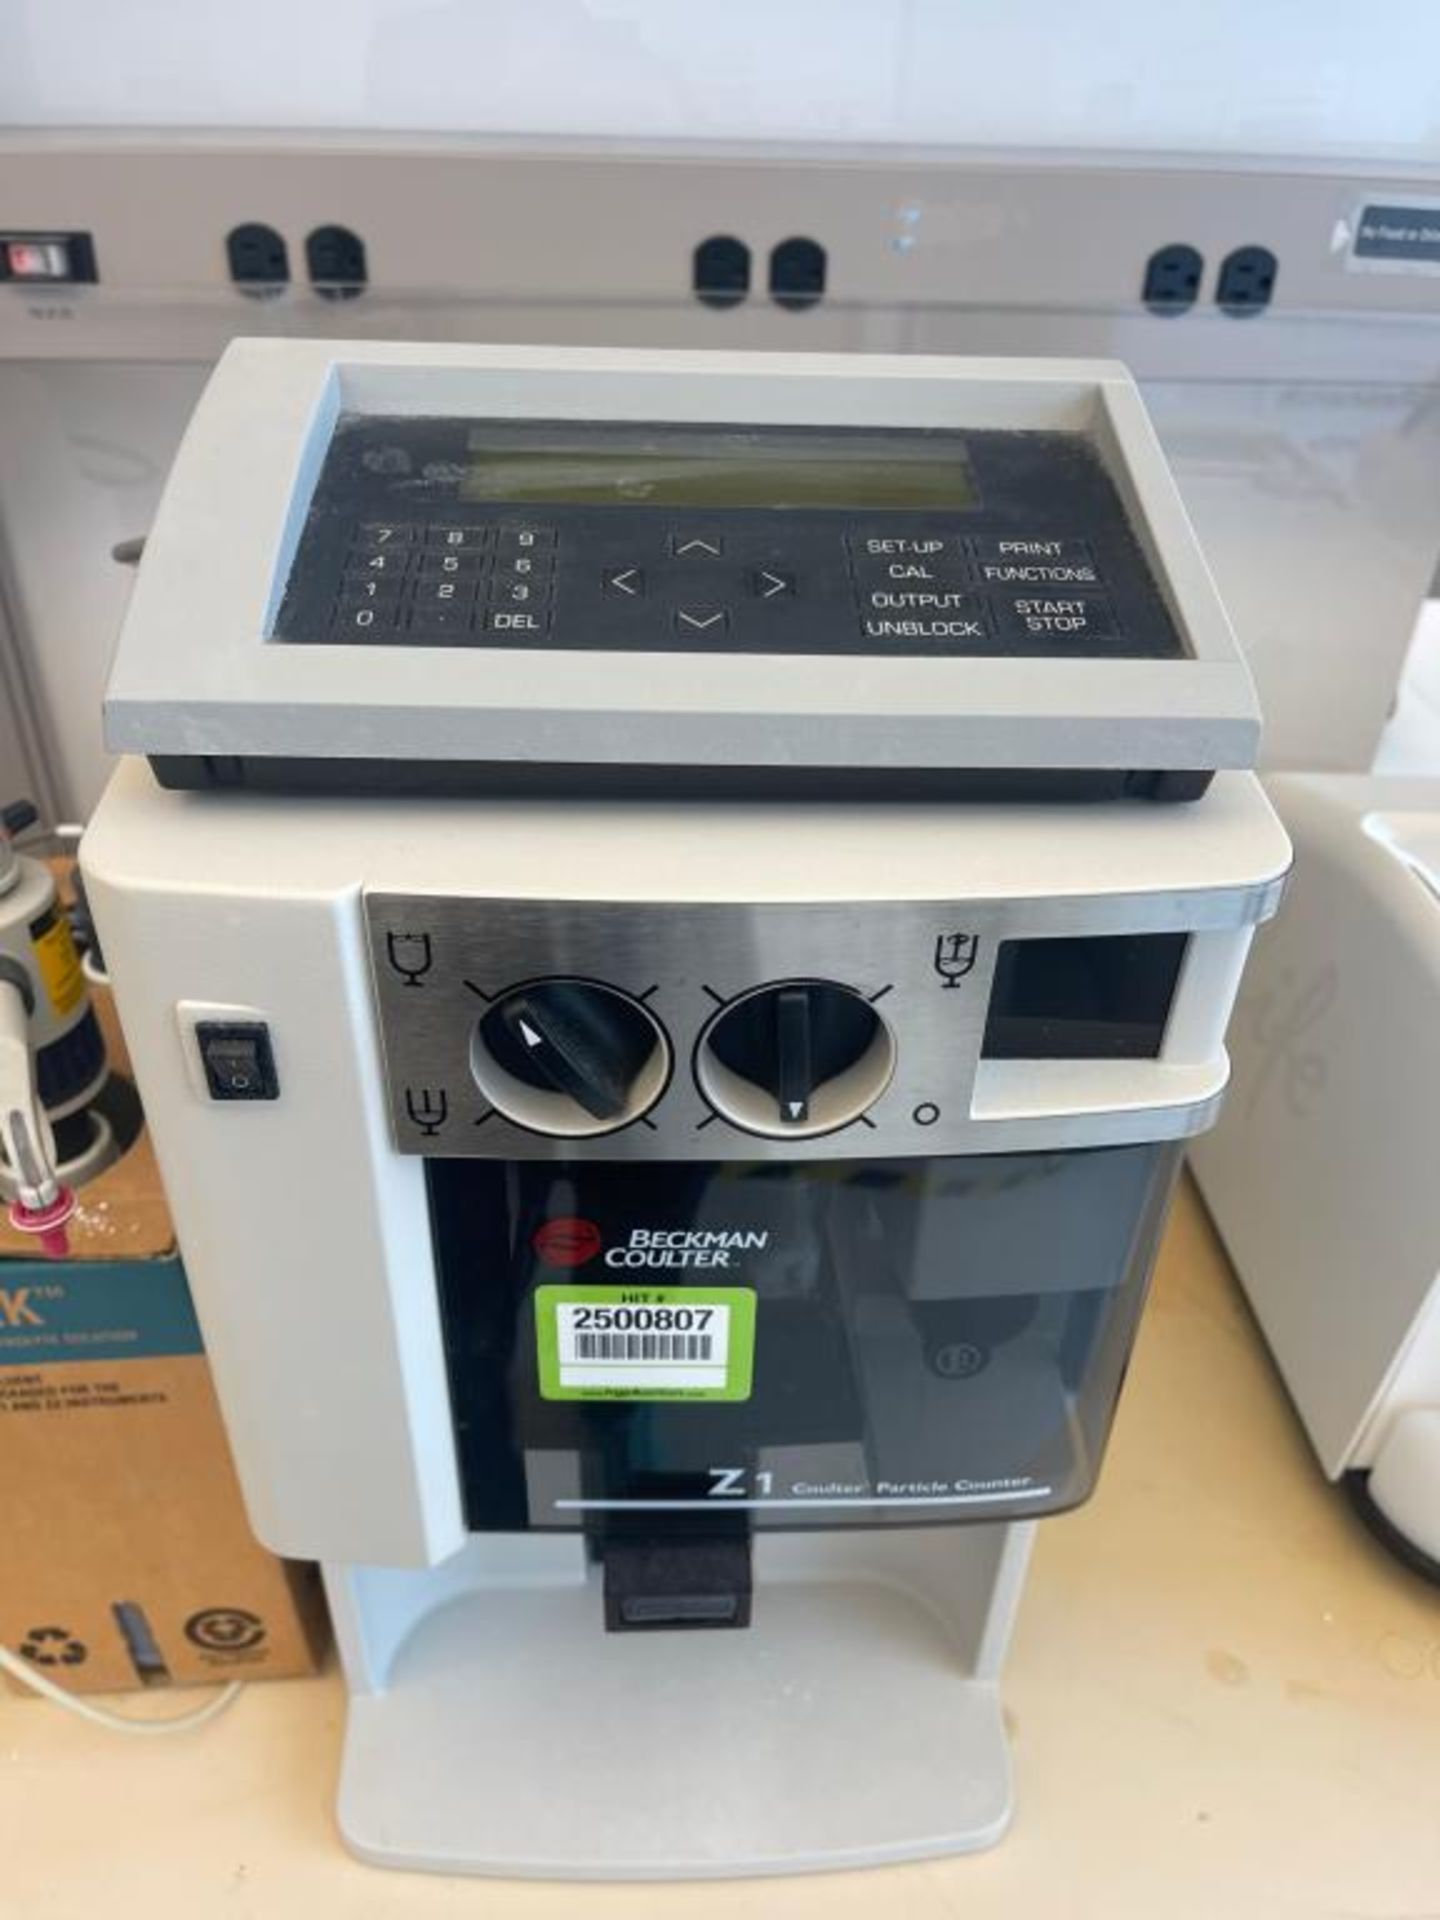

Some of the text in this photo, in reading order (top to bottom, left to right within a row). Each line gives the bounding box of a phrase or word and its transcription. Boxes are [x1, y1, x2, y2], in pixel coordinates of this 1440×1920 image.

[378, 529, 392, 544] 7
[447, 531, 464, 544] 8
[518, 532, 534, 547] 9
[866, 539, 944, 554] SET-UP
[999, 541, 1062, 556] PRINT
[369, 556, 385, 570] 4
[443, 556, 459, 571] 5
[514, 558, 531, 573] 6
[888, 564, 934, 579] CAL
[984, 566, 1096, 581] FUNCTIONS
[366, 582, 377, 597] 1
[438, 584, 455, 599] 2
[511, 584, 528, 601] 3
[871, 593, 961, 609] OUTPUT
[1014, 600, 1086, 614] START
[493, 613, 540, 629] DEL
[866, 620, 982, 637] UNBLOCK
[1025, 616, 1087, 631] STOP
[628, 1229, 769, 1249] BECKMAN
[604, 1247, 730, 1269] COULTER
[572, 1307, 714, 1331] 2500807
